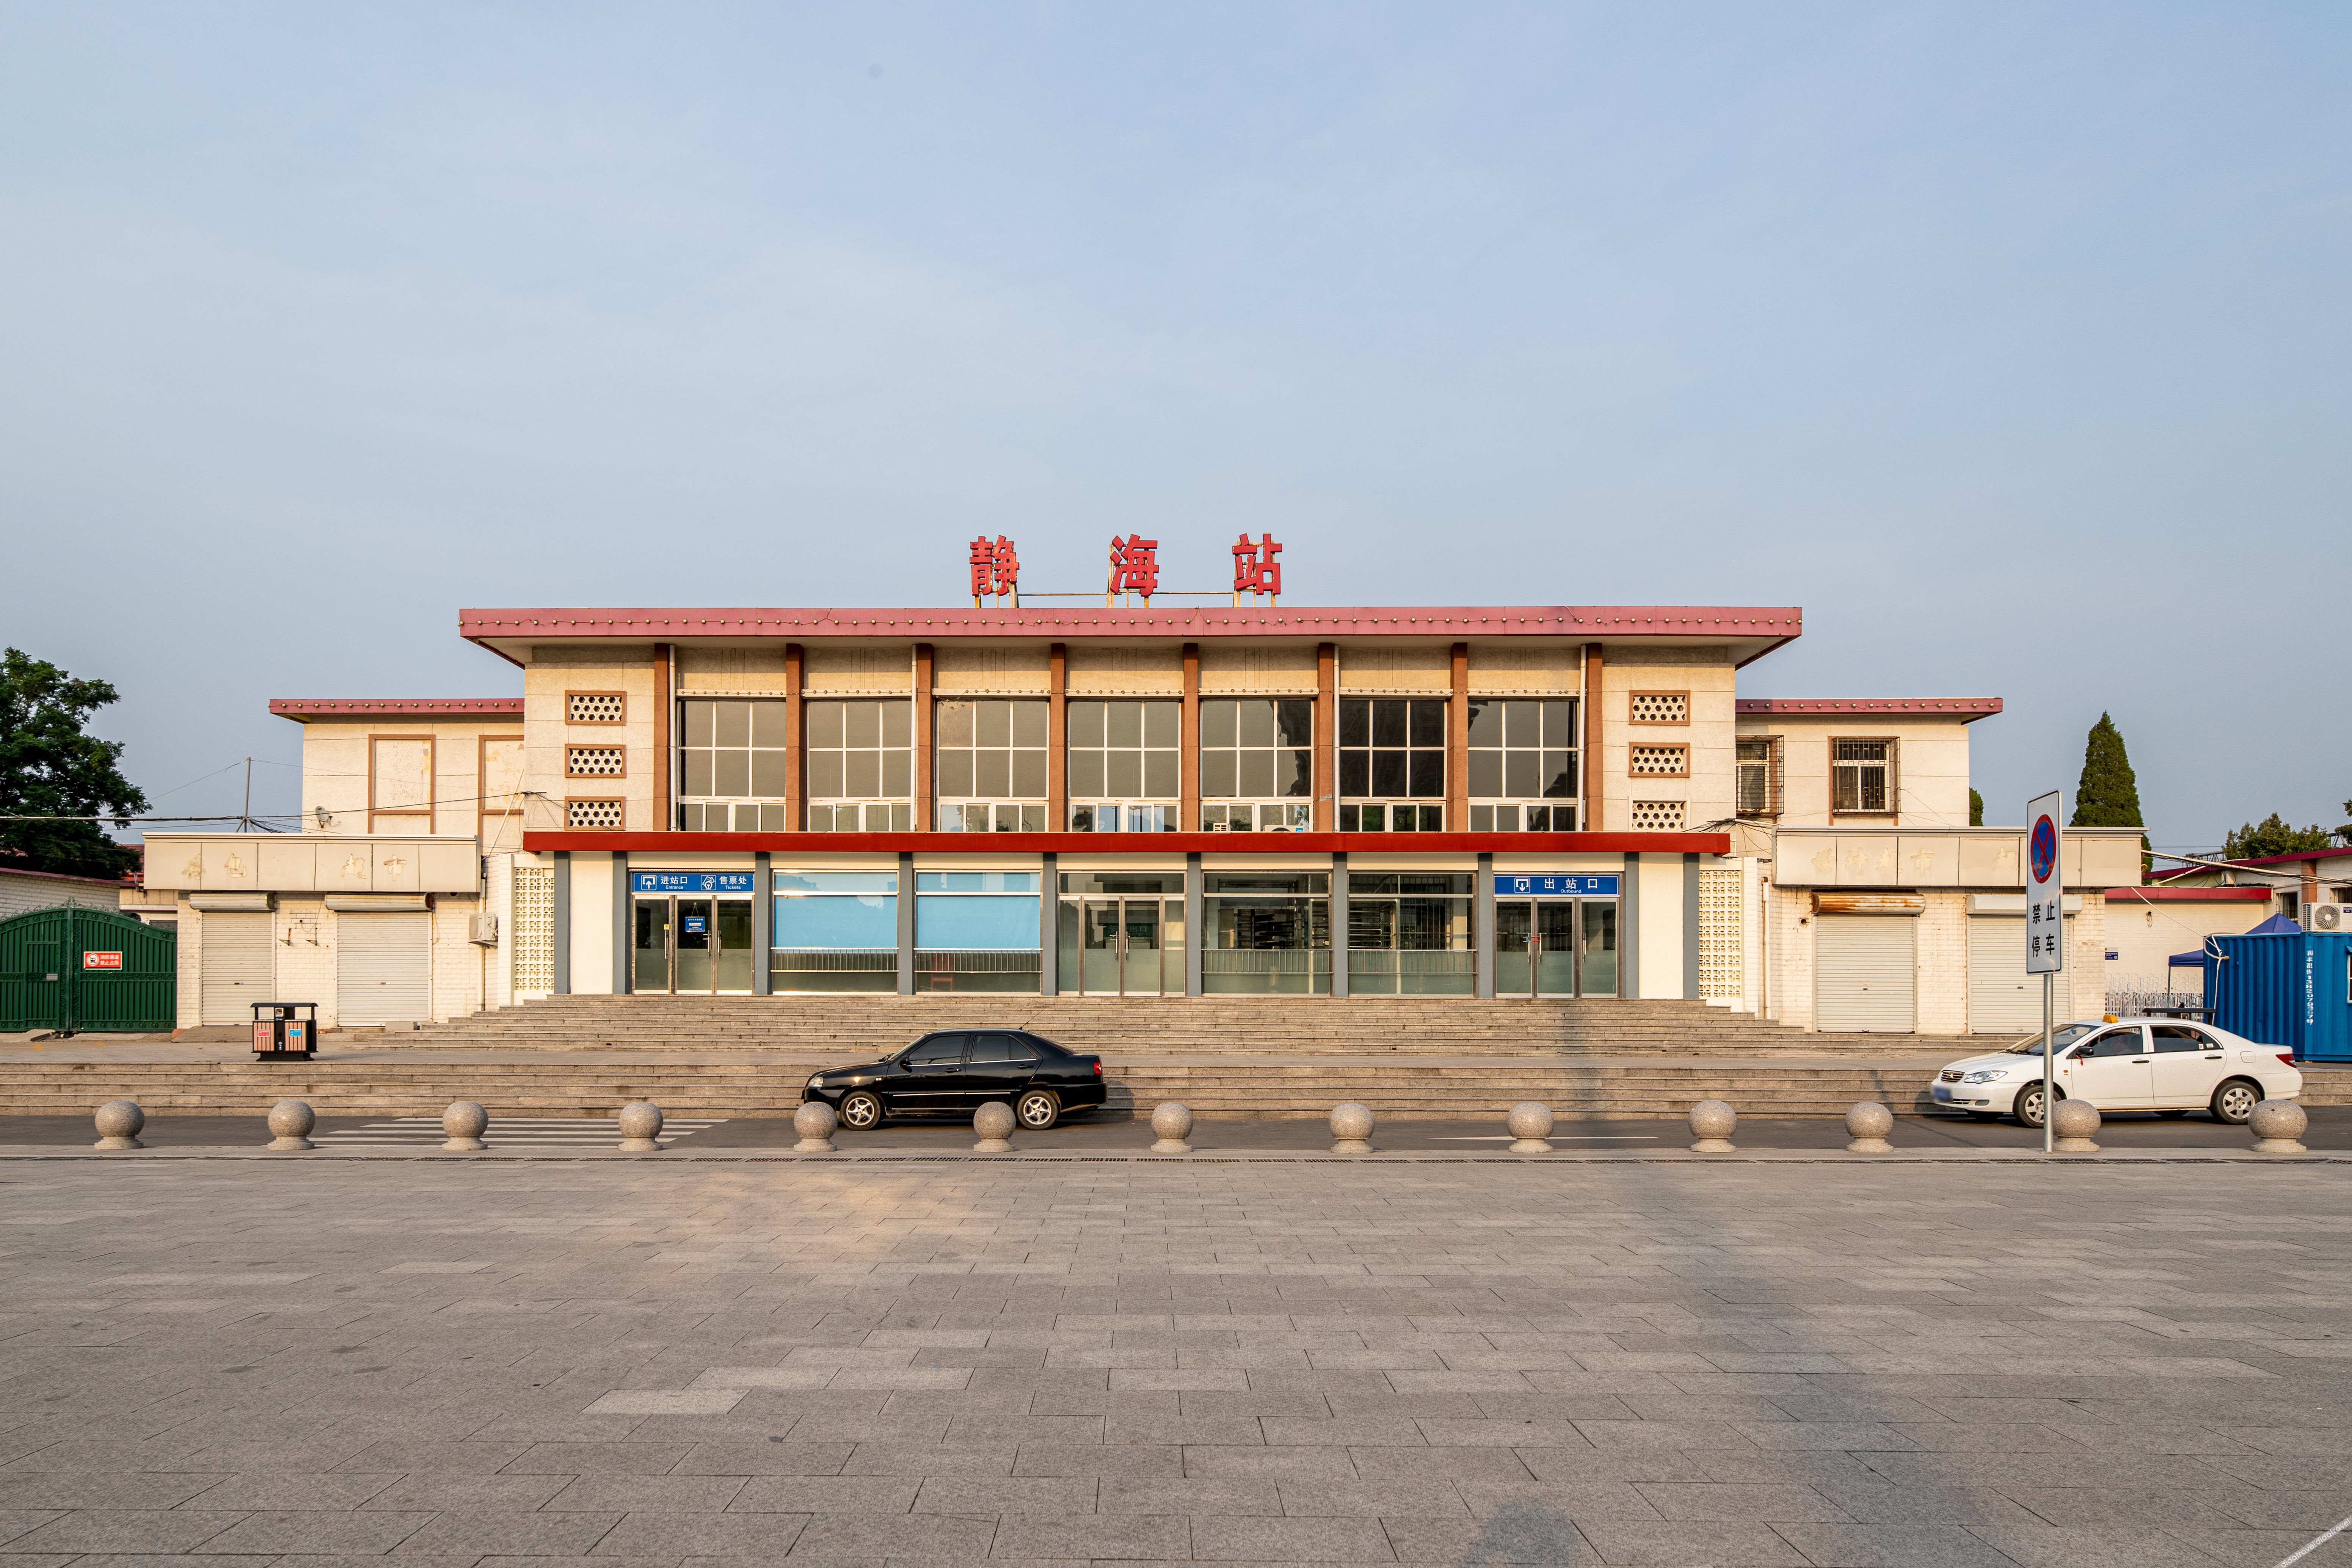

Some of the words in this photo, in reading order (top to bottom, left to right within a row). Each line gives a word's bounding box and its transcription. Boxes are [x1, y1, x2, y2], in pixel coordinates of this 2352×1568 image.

[970, 534, 1282, 596] 静海站
[661, 876, 688, 884] 进站口
[719, 876, 747, 884] 售票处
[1544, 877, 1597, 889] 出站口
[2033, 899, 2055, 924] 禁止
[2032, 934, 2055, 957] 停车
